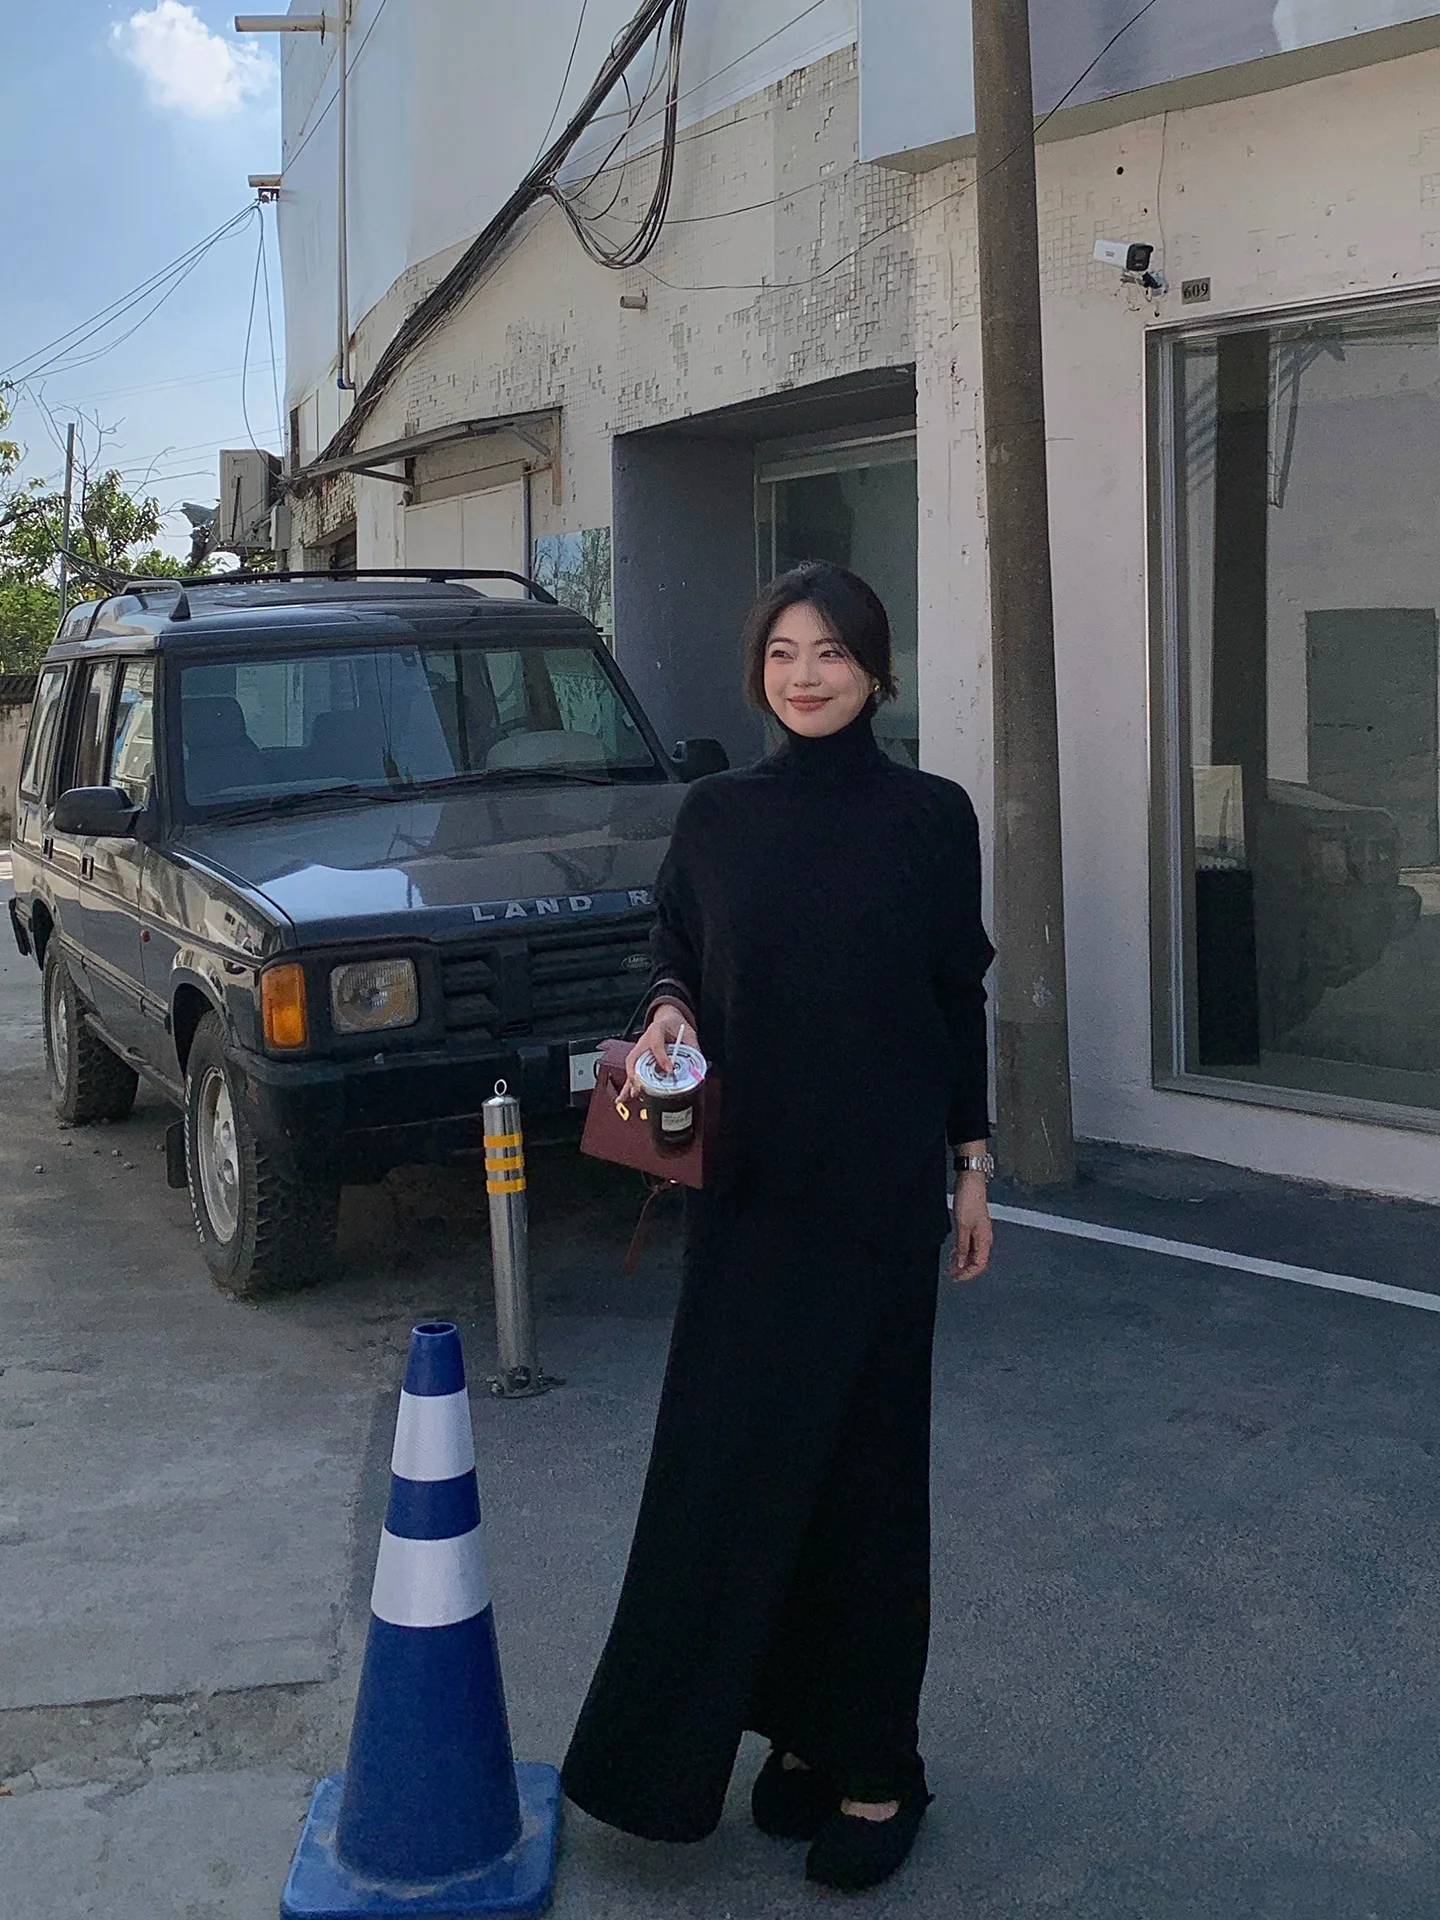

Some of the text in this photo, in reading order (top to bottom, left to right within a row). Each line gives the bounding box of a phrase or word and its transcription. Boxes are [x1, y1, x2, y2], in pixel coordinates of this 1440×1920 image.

[1183, 282, 1209, 299] 609
[472, 890, 651, 922] LAND R
